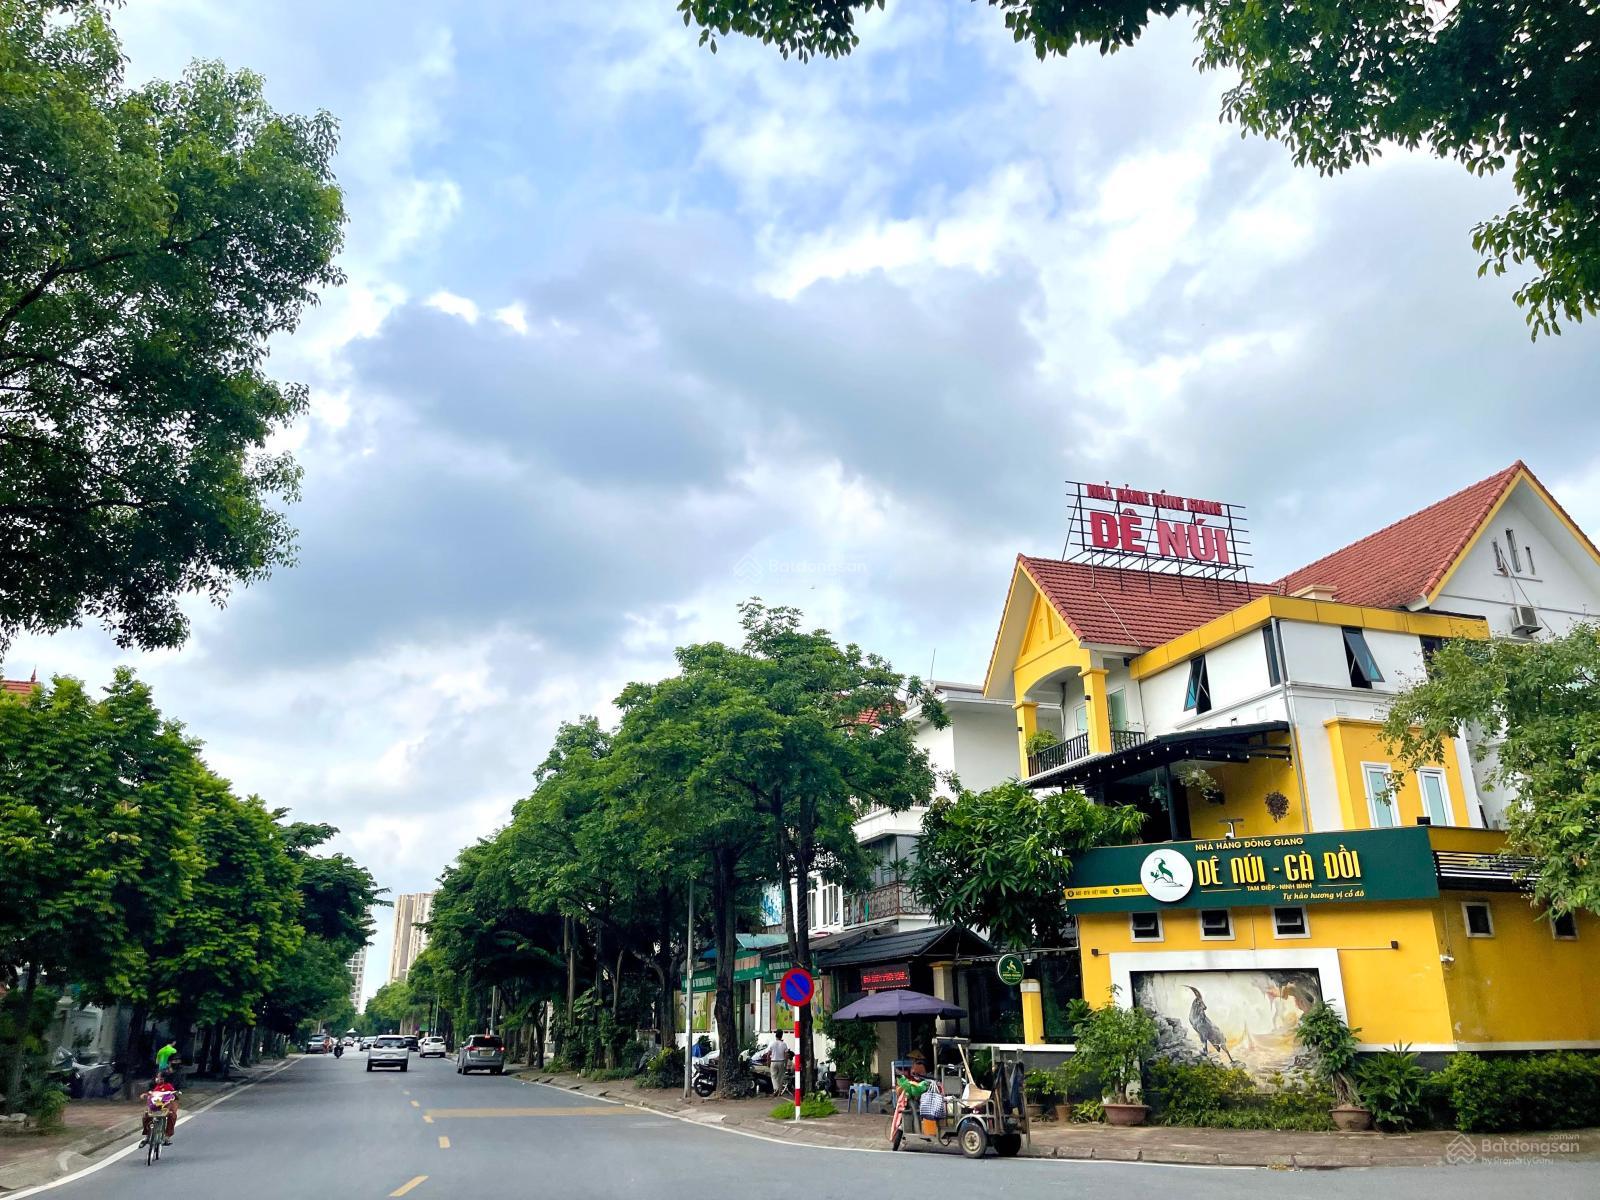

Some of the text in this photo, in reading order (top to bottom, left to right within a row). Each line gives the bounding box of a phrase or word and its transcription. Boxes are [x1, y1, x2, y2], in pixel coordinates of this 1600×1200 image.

[1090, 508, 1230, 564] DÊ NÚI
[1195, 838, 1304, 851] NHÀ HÀNG ĐÔNG GIANG
[1196, 855, 1223, 886] DÊ
[1230, 853, 1266, 884] NÚI
[1283, 850, 1315, 882] GÀ
[1323, 844, 1362, 880] ĐỒI
[1282, 892, 1292, 902] Tự
[1310, 892, 1334, 900] hương
[1336, 890, 1342, 900] vị
